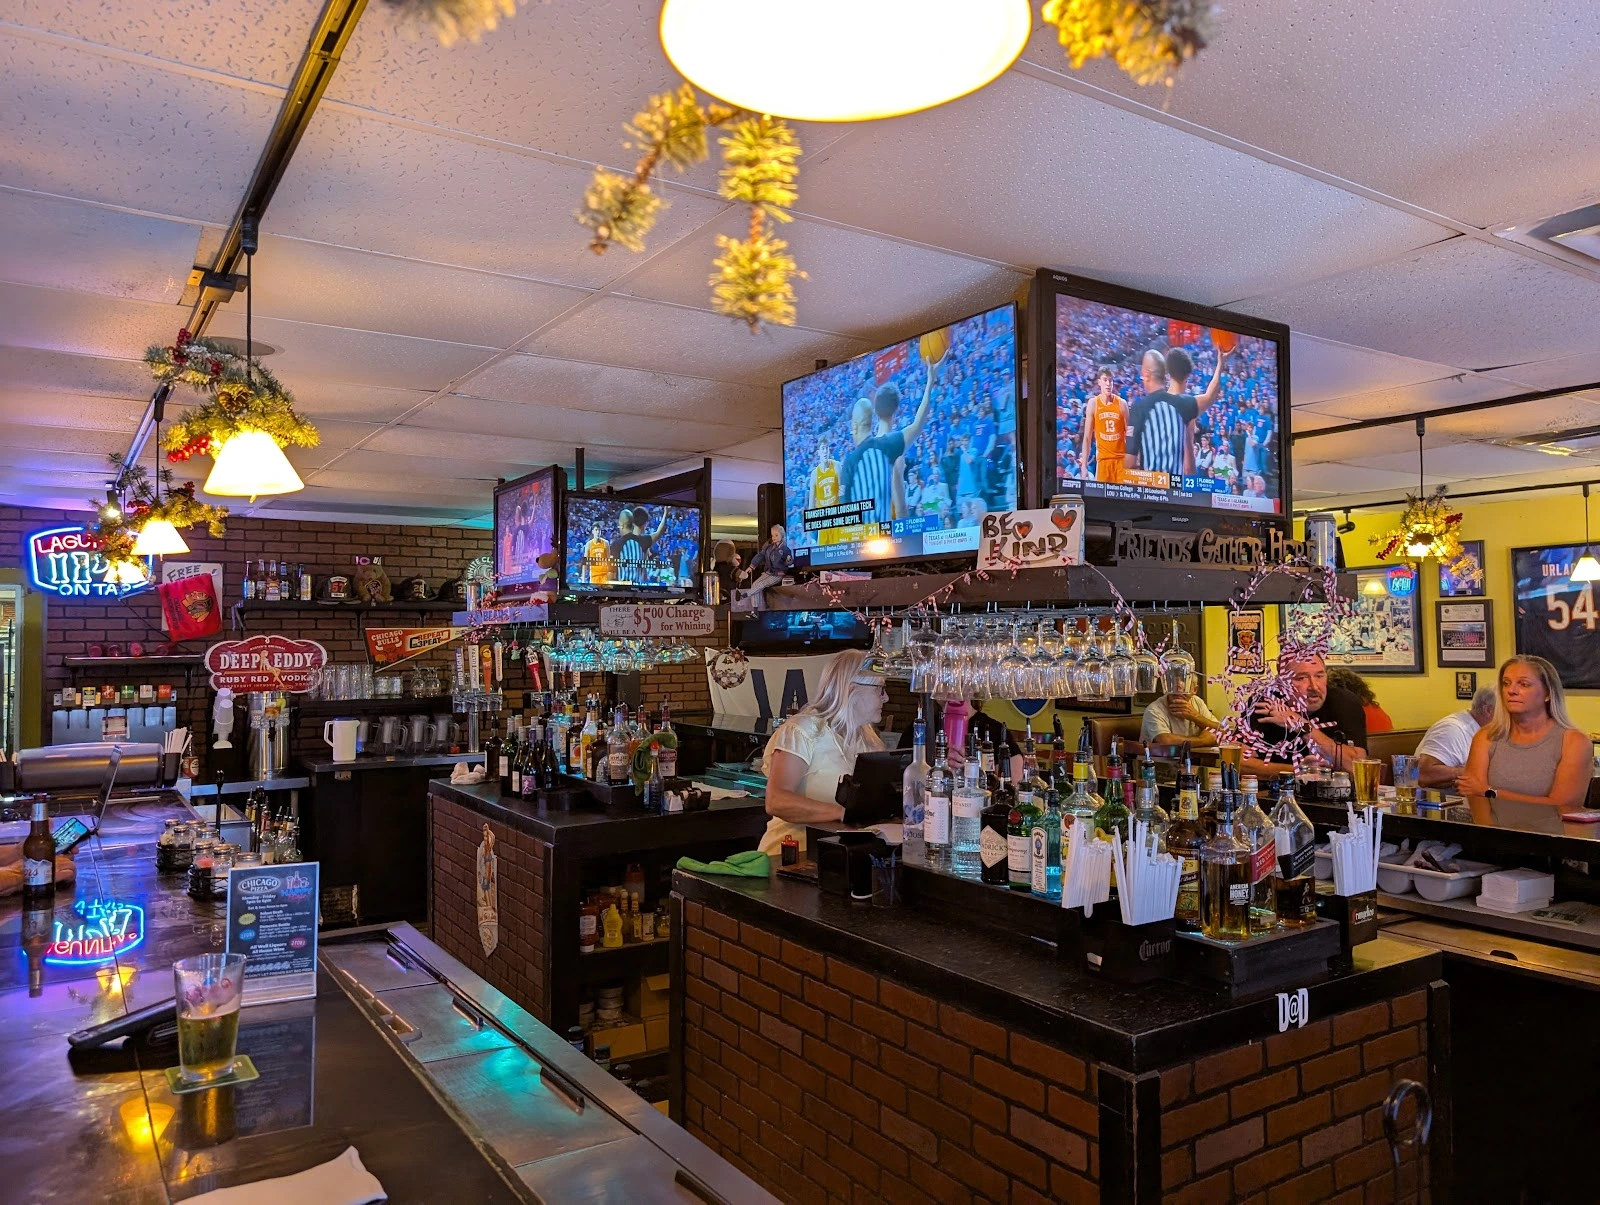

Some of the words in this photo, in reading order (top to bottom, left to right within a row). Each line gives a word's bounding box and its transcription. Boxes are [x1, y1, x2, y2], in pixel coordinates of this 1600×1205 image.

[1105, 420, 1116, 433] 13
[1062, 480, 1081, 488] ESPN
[1158, 475, 1167, 485] 21
[1185, 478, 1195, 488] 23
[805, 510, 825, 520] TRANSFER
[825, 508, 837, 517] FROM
[837, 503, 860, 514] LOUISIANA
[822, 518, 833, 528] HAVE
[894, 523, 904, 533] 23
[983, 512, 1014, 539] BE
[868, 526, 877, 536] 21
[990, 533, 1068, 561] KIND
[1112, 520, 1194, 562] FRIENDS
[1198, 528, 1262, 565] GATHER
[166, 565, 202, 582] FREE
[467, 559, 480, 579] WHITE
[59, 583, 91, 596] ON
[1546, 583, 1599, 631] 54
[666, 606, 705, 621] Charge
[661, 622, 673, 631] for
[675, 621, 711, 632] Whining
[371, 629, 404, 641] CHICAGO
[376, 636, 400, 647] BULLS
[220, 653, 260, 669] DEEP
[273, 652, 314, 668] EDDY
[251, 675, 269, 683] RED
[281, 674, 314, 682] VODKA
[1255, 858, 1264, 868] RED
[241, 878, 278, 890] CHICAGO
[1229, 888, 1249, 899] HONEY
[1138, 939, 1172, 962] Cuervo
[1274, 987, 1309, 1033] D@D
